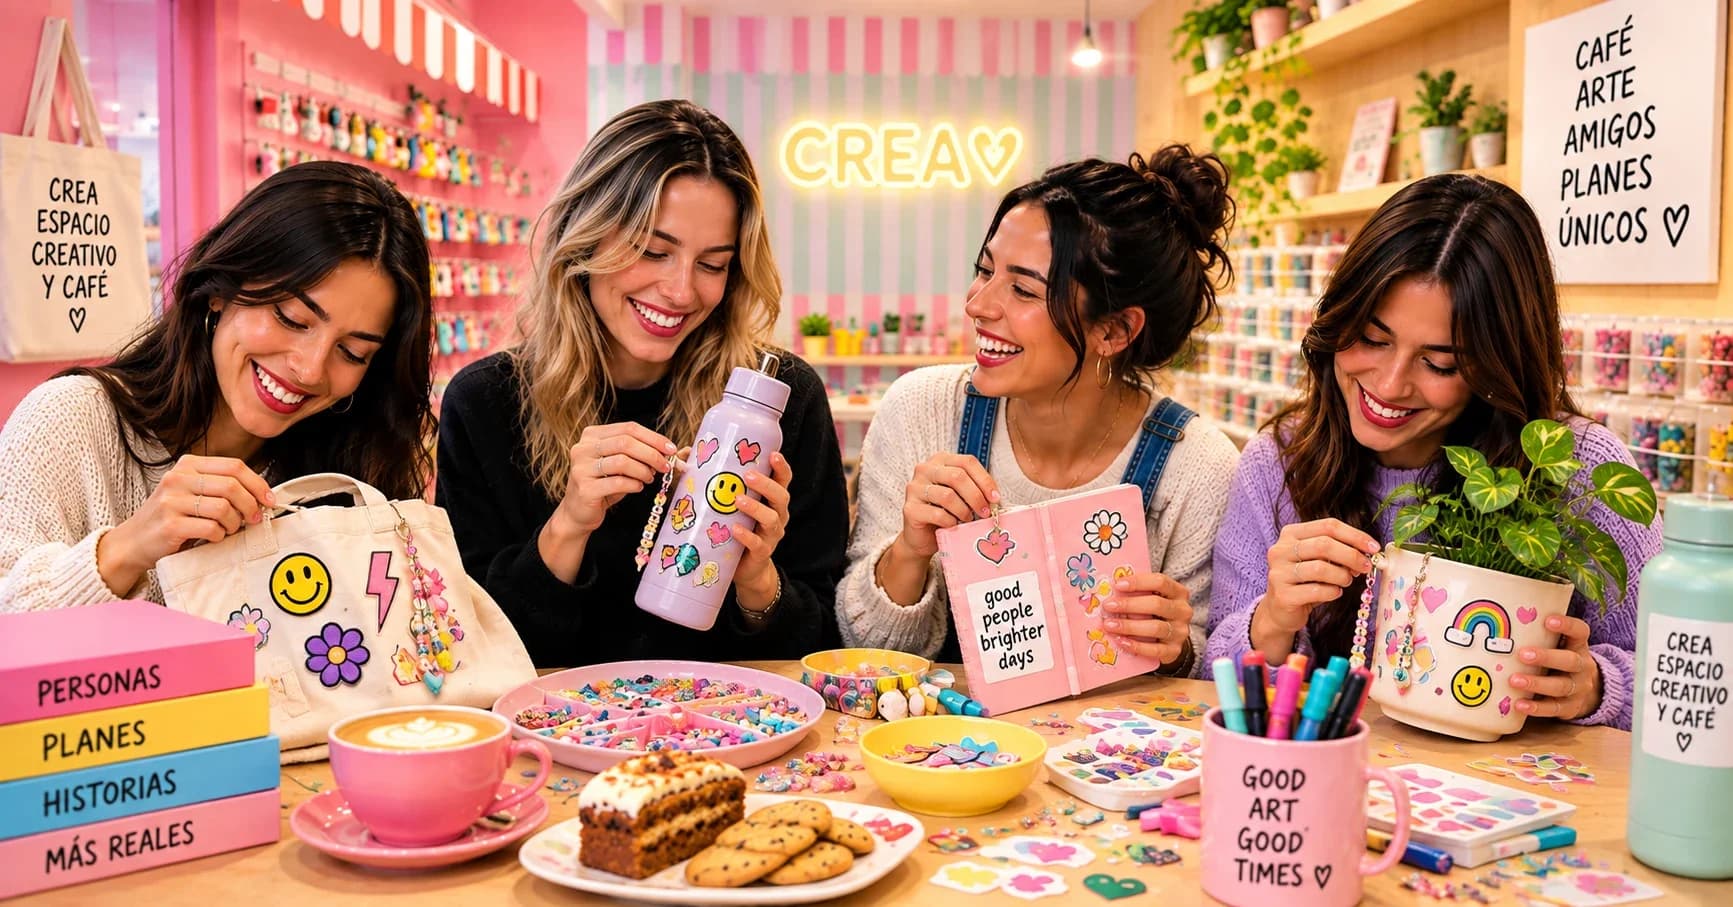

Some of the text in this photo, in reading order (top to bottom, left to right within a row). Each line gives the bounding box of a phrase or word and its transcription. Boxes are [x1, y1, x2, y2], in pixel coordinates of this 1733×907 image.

[1576, 14, 1634, 70] CAFÉ
[1575, 66, 1636, 111] ARTE
[1563, 105, 1656, 156] AMIGOS
[781, 121, 970, 188] CREA
[49, 177, 98, 205] CREA
[1561, 154, 1652, 201] PLANES
[37, 209, 110, 236] ESPACIO
[1559, 206, 1648, 248] ÚNICOS
[31, 241, 117, 267] CREATIVO
[42, 269, 109, 299] Y CAFÉ
[984, 580, 1023, 610] good
[982, 602, 1034, 633] people
[980, 624, 1045, 652] brighter
[1666, 631, 1712, 656] CREA
[998, 649, 1034, 670] days
[1657, 654, 1724, 681] ESPACIO
[37, 664, 162, 708] PERSONAS
[1651, 677, 1728, 706] CREATIVO
[1656, 702, 1716, 730] Y CAFÉ
[42, 720, 147, 762] PLANES
[1242, 764, 1306, 792] GOOD
[43, 769, 177, 818] HISTORIAS
[1248, 797, 1300, 823] ART
[45, 820, 195, 875] MÁS REALES
[1237, 826, 1304, 855] GOOD
[1233, 857, 1304, 888] TIMES
